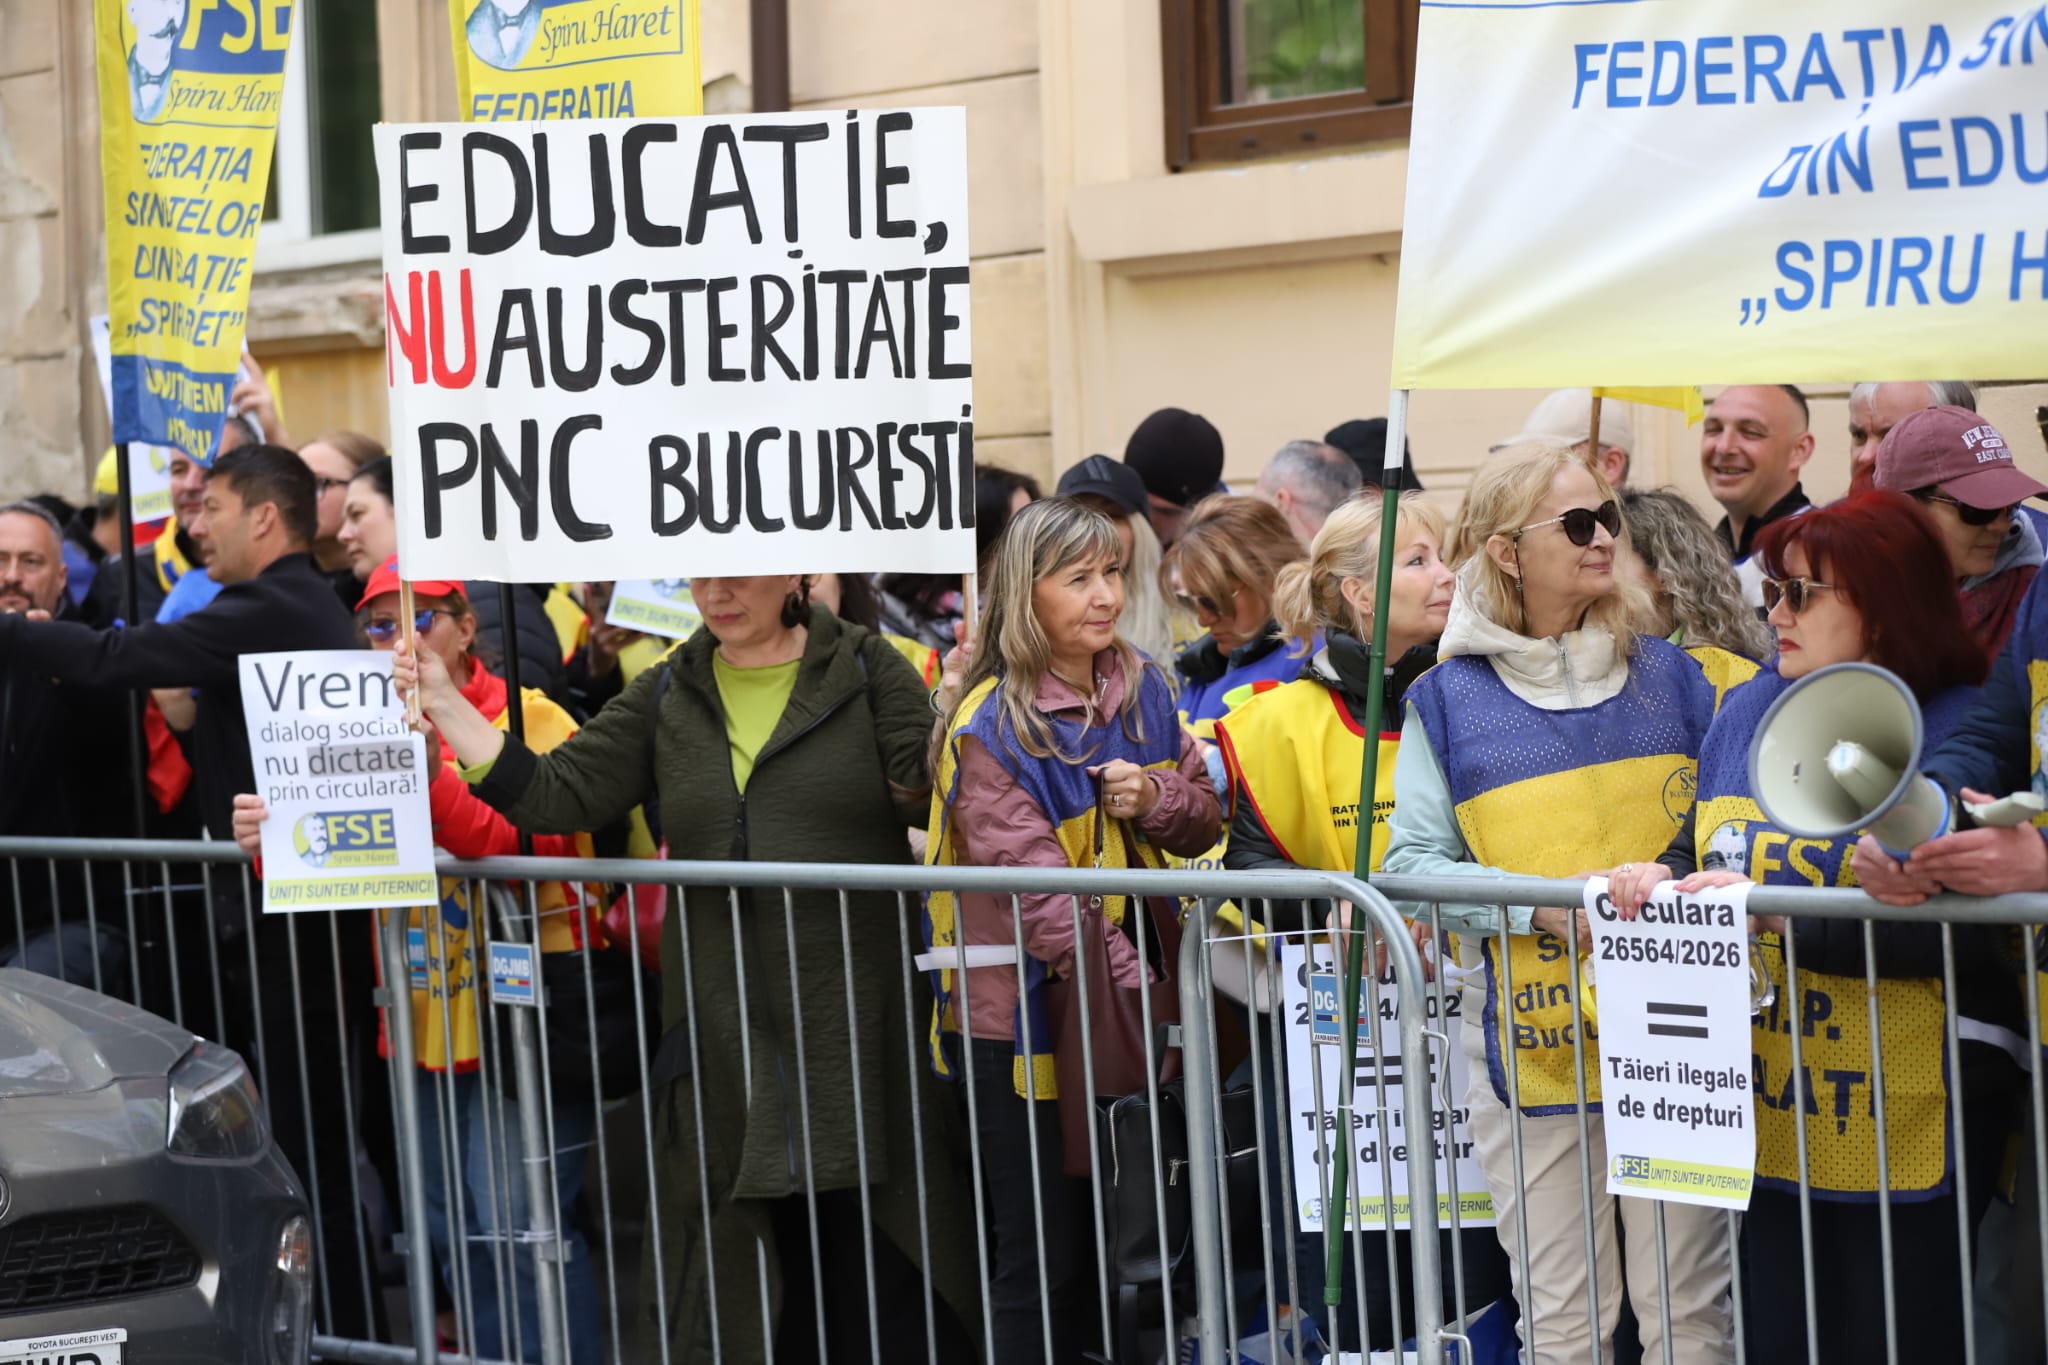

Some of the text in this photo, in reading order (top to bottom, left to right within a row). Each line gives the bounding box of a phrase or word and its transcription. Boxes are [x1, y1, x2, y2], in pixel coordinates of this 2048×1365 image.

[540, 4, 675, 62] Spiru Haret
[1571, 24, 1950, 117] FEDERAȚIA
[167, 80, 226, 118] Spiru
[1757, 125, 1874, 198] DIN
[385, 264, 972, 392] NU AUSTERITATE
[418, 403, 975, 542] PNC BUCURESTI
[1976, 450, 1997, 463] EAST
[254, 660, 406, 713] Vrem
[261, 720, 331, 745] dialog
[265, 745, 415, 776] nu dictate
[269, 774, 418, 806] prin circulară!
[325, 811, 395, 846] FSE
[269, 884, 302, 904] UNIȚI
[307, 882, 359, 899] SUNTEM
[1595, 892, 1735, 928] Cculara
[1601, 935, 1741, 968] 26564/2026
[1514, 981, 1572, 1014] din
[1608, 1056, 1747, 1093] Tăieri ilegale
[1618, 1094, 1743, 1130] de drepturi
[1624, 1157, 1649, 1176] FSE
[1651, 1168, 1671, 1184] UNIȚI
[1673, 1170, 1704, 1185] SUNTEM
[28, 1339, 58, 1350] TOYOTA
[100, 1333, 118, 1341] VEST
